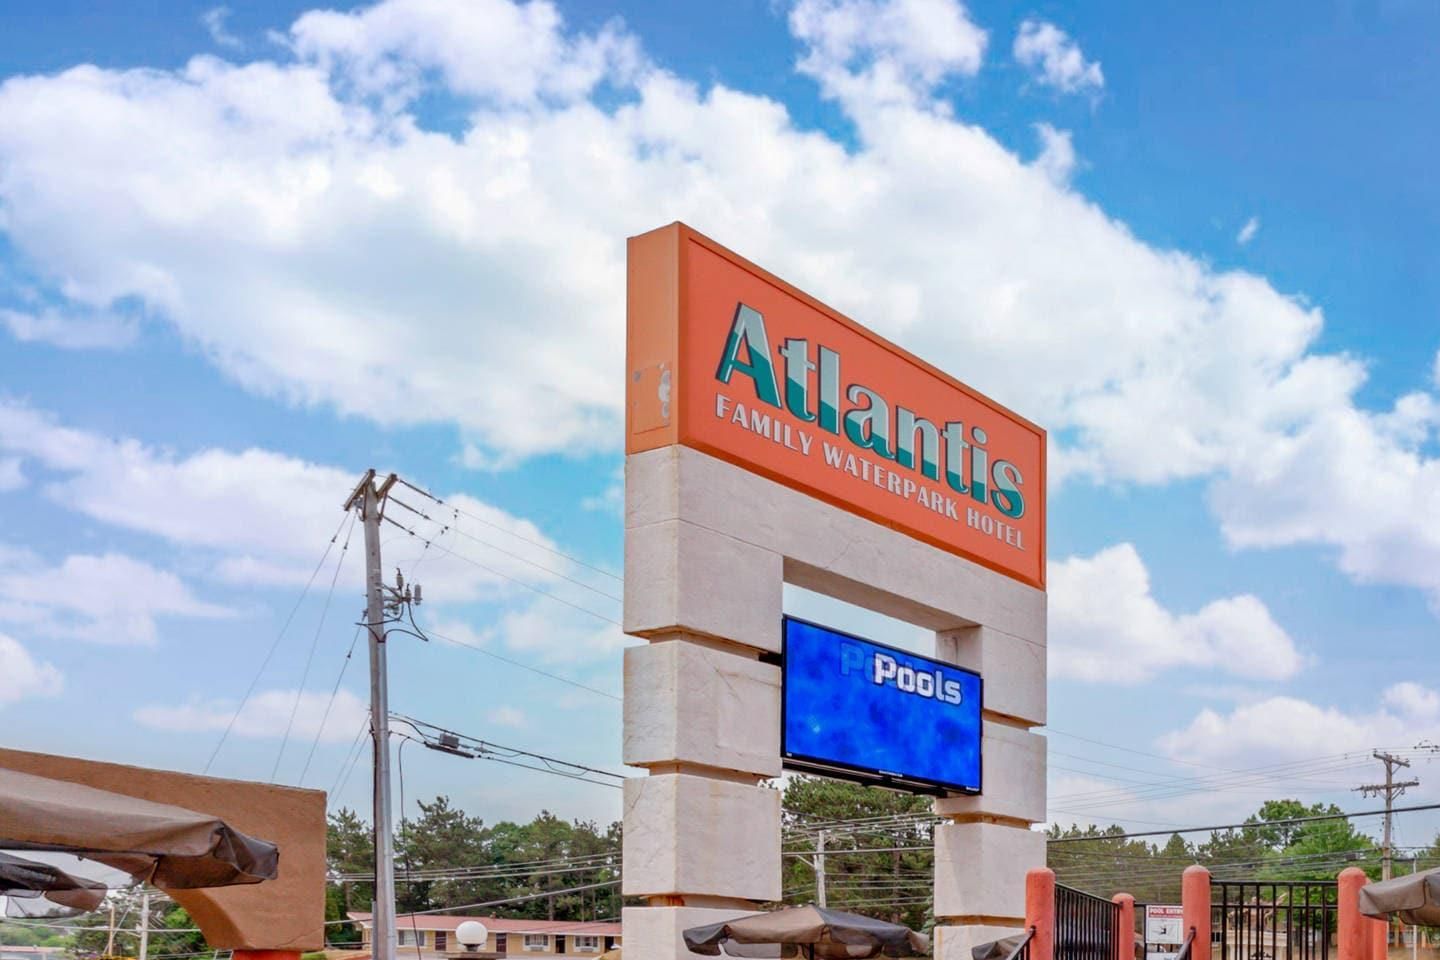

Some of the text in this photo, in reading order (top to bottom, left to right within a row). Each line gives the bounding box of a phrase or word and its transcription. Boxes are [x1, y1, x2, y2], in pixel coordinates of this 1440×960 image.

[715, 302, 1025, 519] Atlantis
[716, 392, 1024, 551] FAMILY WATERPARK HOTEL
[874, 652, 962, 705] Pools
